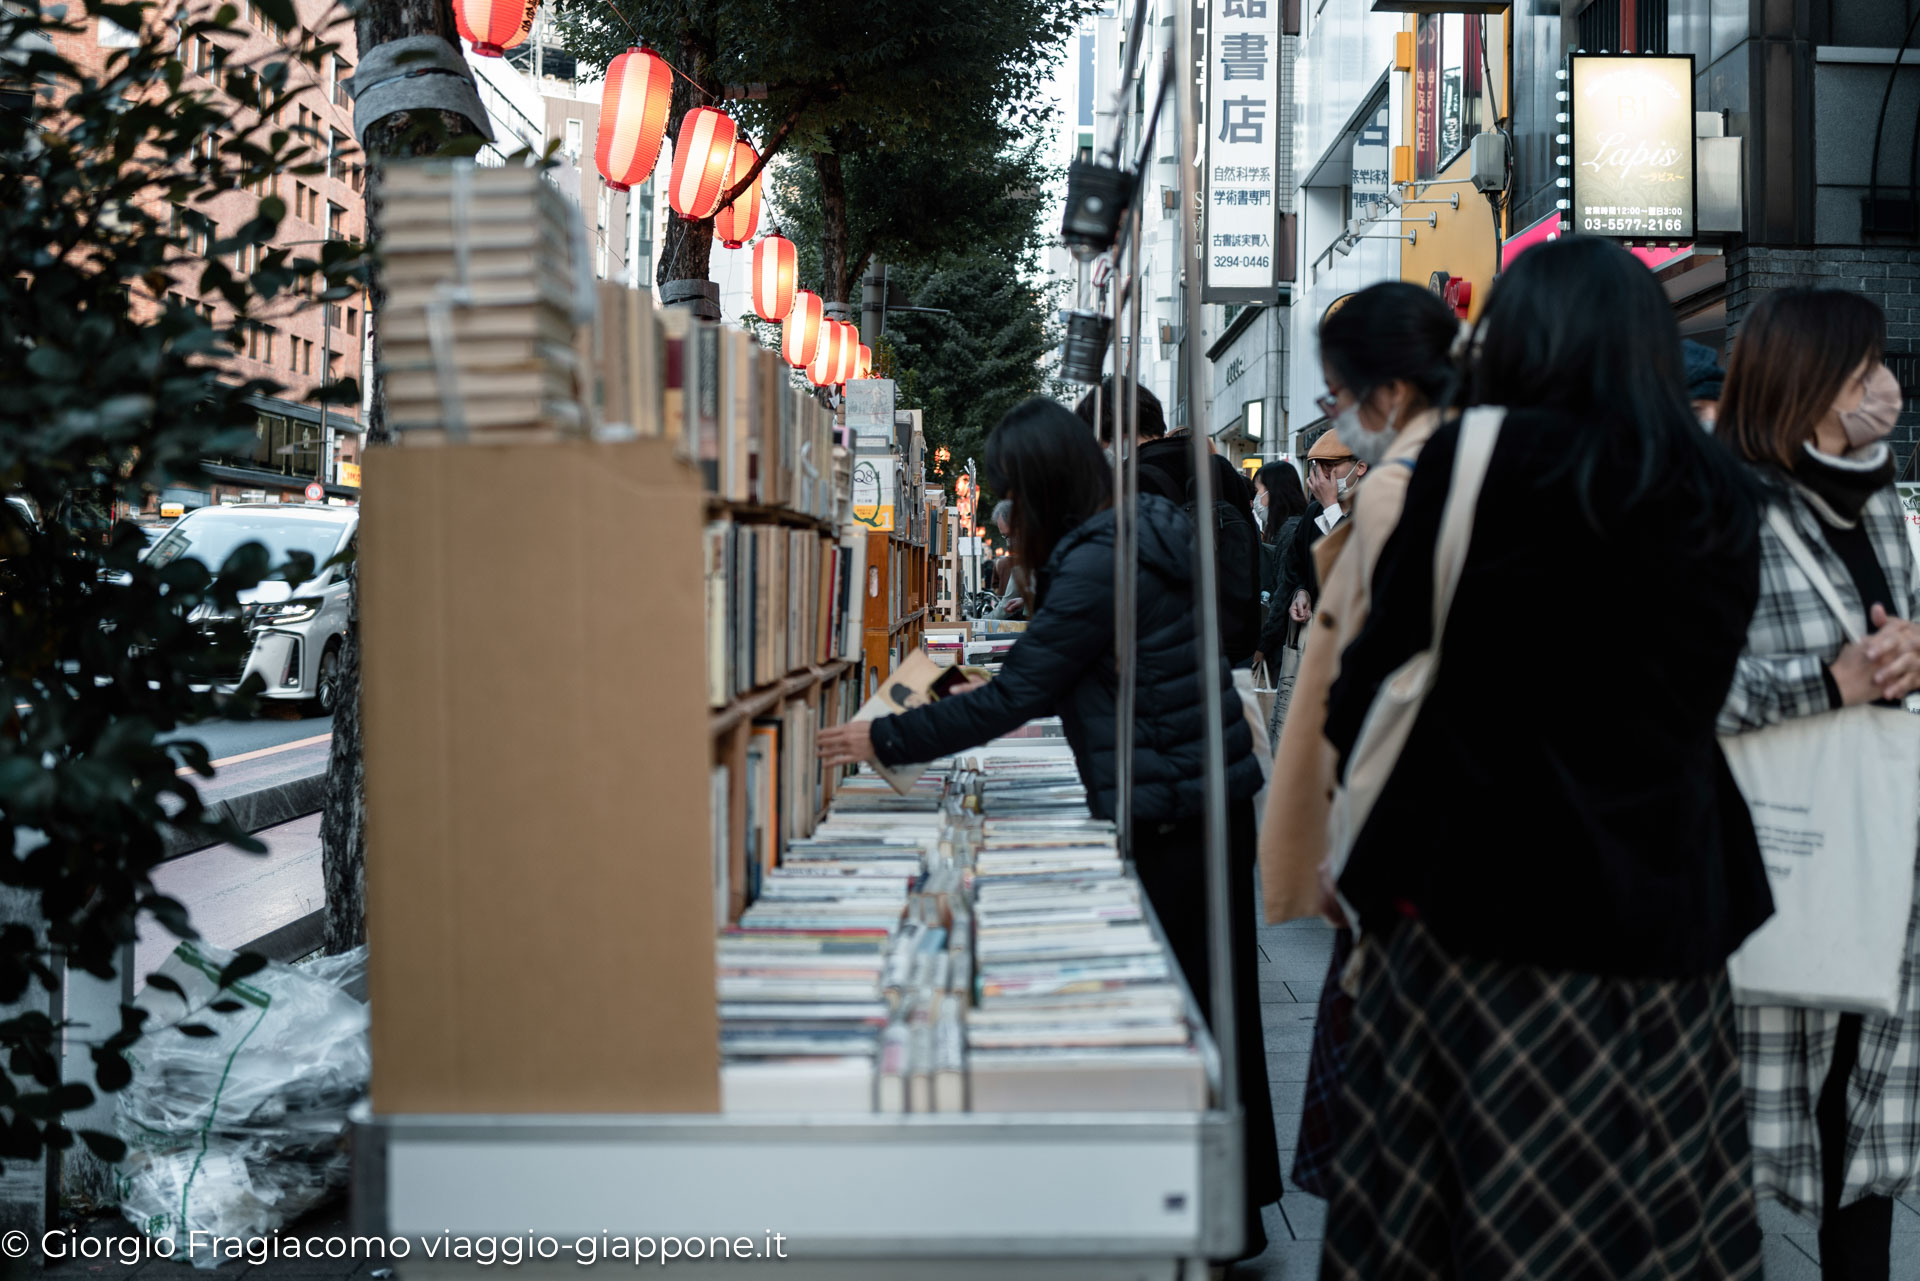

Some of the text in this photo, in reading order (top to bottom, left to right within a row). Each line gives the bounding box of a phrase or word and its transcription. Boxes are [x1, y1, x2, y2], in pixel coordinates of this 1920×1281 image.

[1582, 132, 1683, 179] Lapis
[1214, 166, 1271, 182] 自然科学系
[1214, 190, 1271, 206] 学術書専門
[1584, 218, 1682, 231] 03-5577-2166
[1213, 234, 1270, 248] 古書誠実買入
[1214, 255, 1270, 268] 3294-0446
[882, 512, 892, 528] 1
